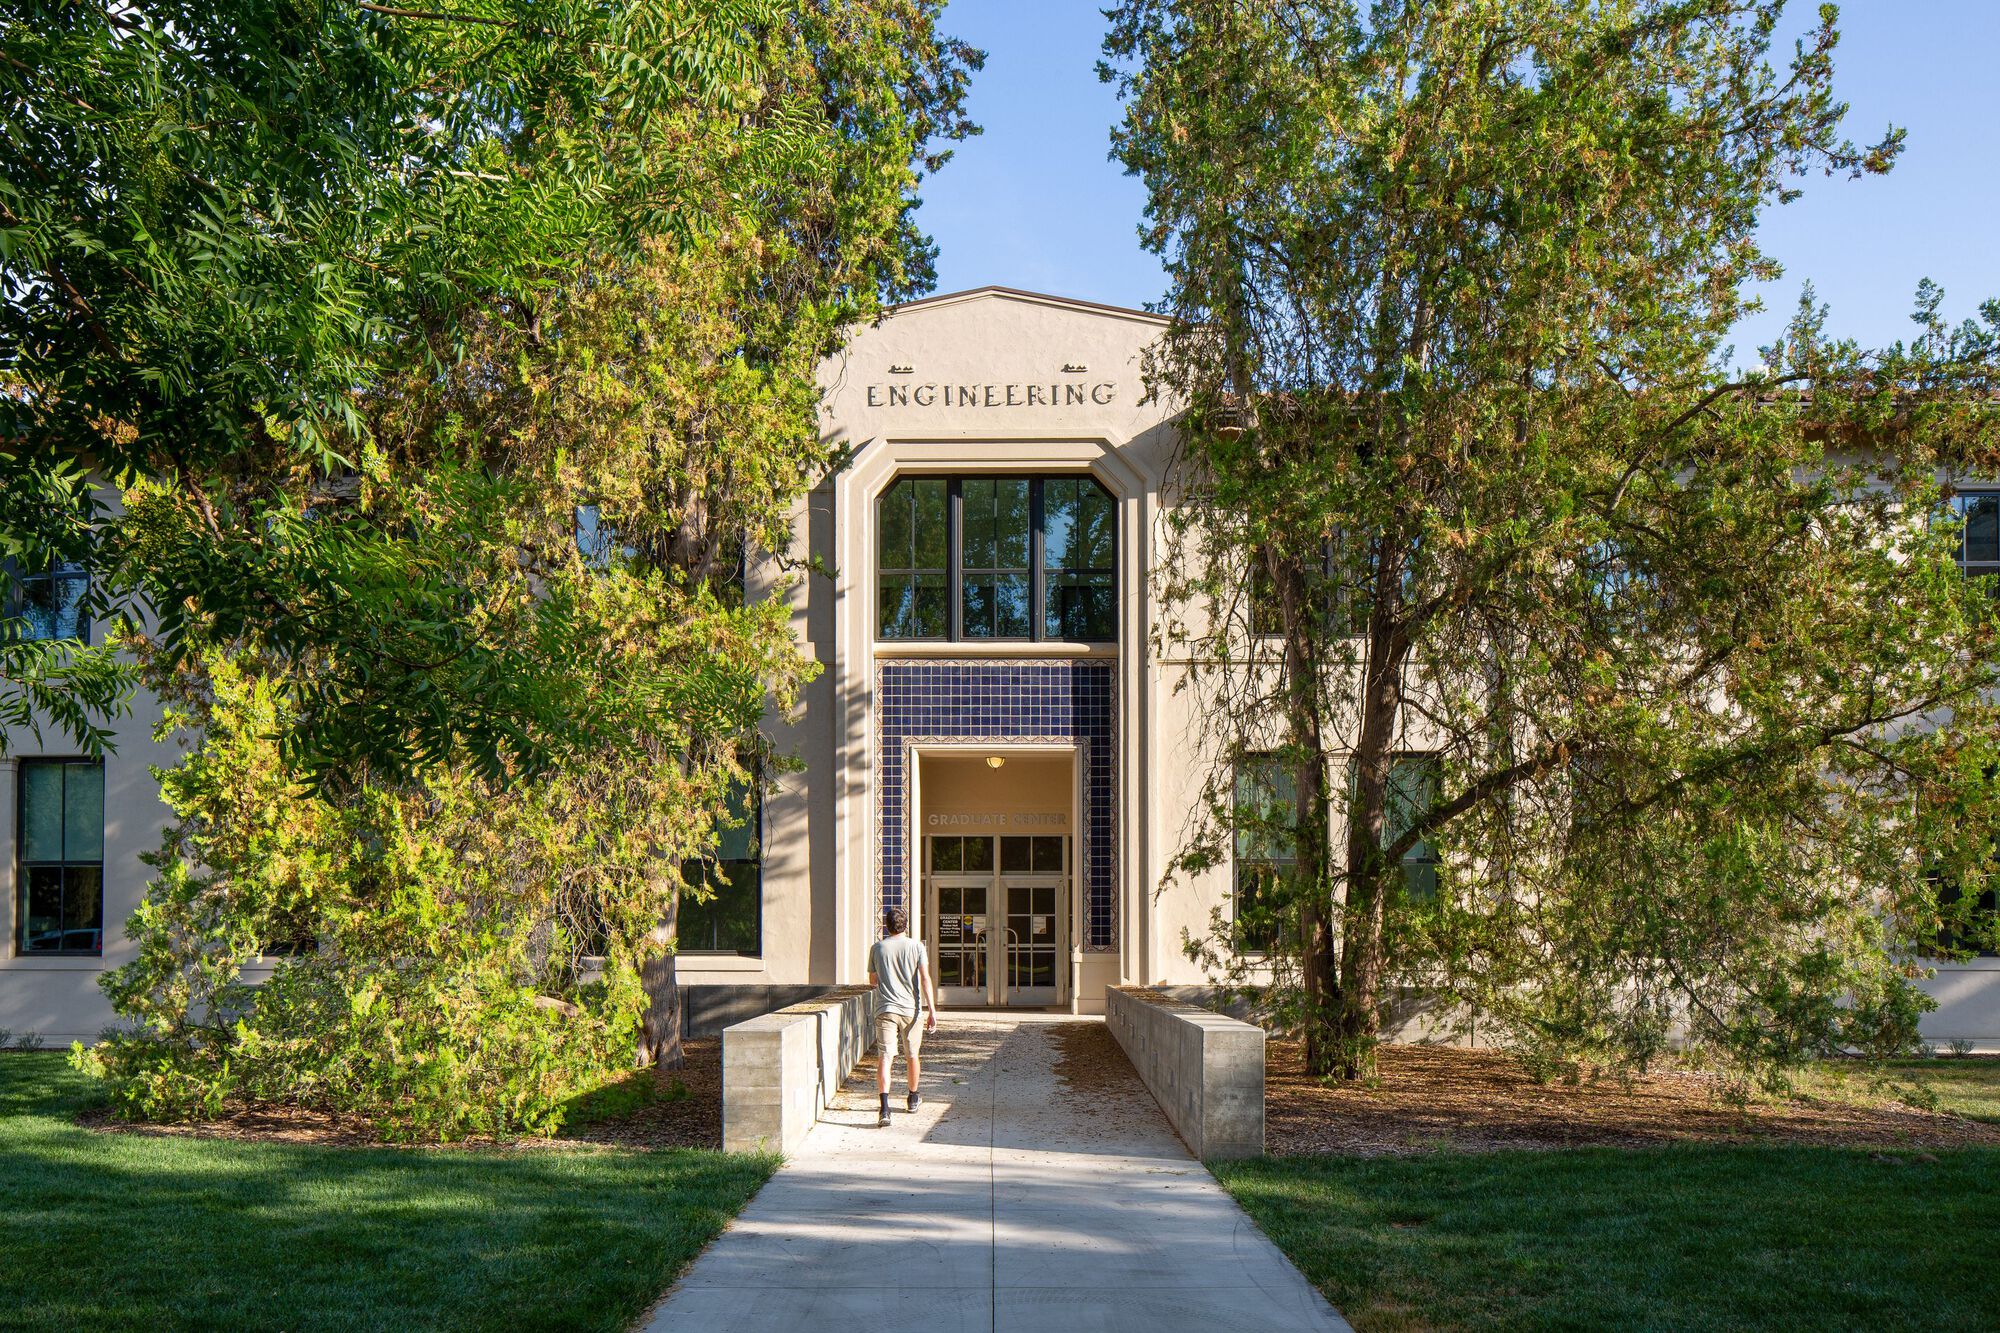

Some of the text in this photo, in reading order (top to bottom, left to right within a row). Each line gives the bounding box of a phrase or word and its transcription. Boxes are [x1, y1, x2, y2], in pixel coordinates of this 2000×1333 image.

[867, 383, 1116, 407] ENGINEERING
[928, 814, 1066, 826] GRADUATE CENTER
